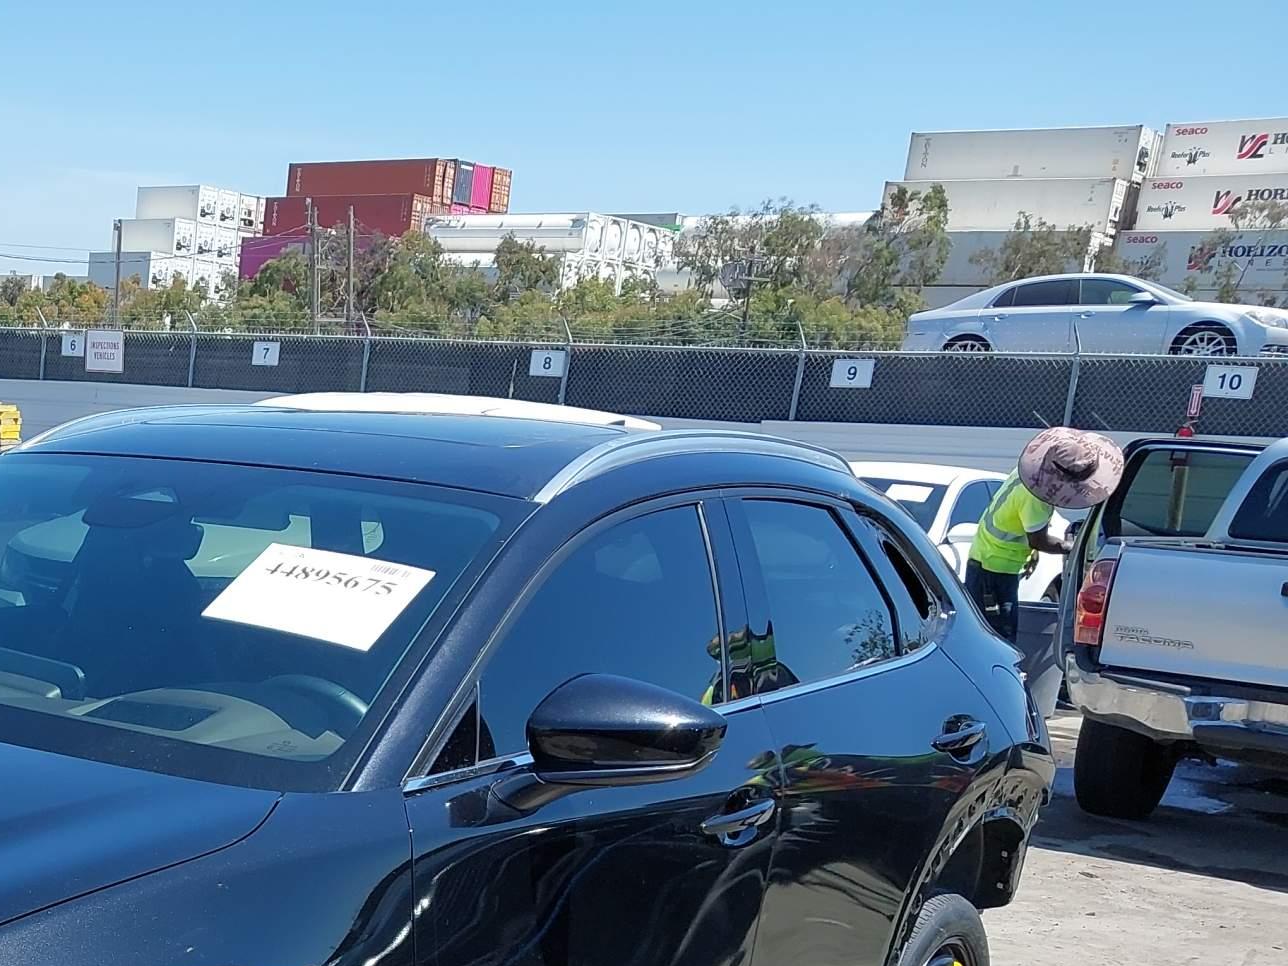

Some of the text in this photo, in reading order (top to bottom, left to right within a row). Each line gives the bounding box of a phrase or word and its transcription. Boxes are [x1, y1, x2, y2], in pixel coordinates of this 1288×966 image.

[1175, 127, 1209, 136] seaco
[1152, 181, 1184, 190] seaco
[1126, 235, 1159, 244] seaco
[70, 339, 77, 352] 6
[263, 347, 270, 360] 7
[542, 356, 552, 370] 8
[846, 366, 858, 381] 9
[1218, 372, 1243, 391] 10
[265, 562, 399, 595] 44895675
